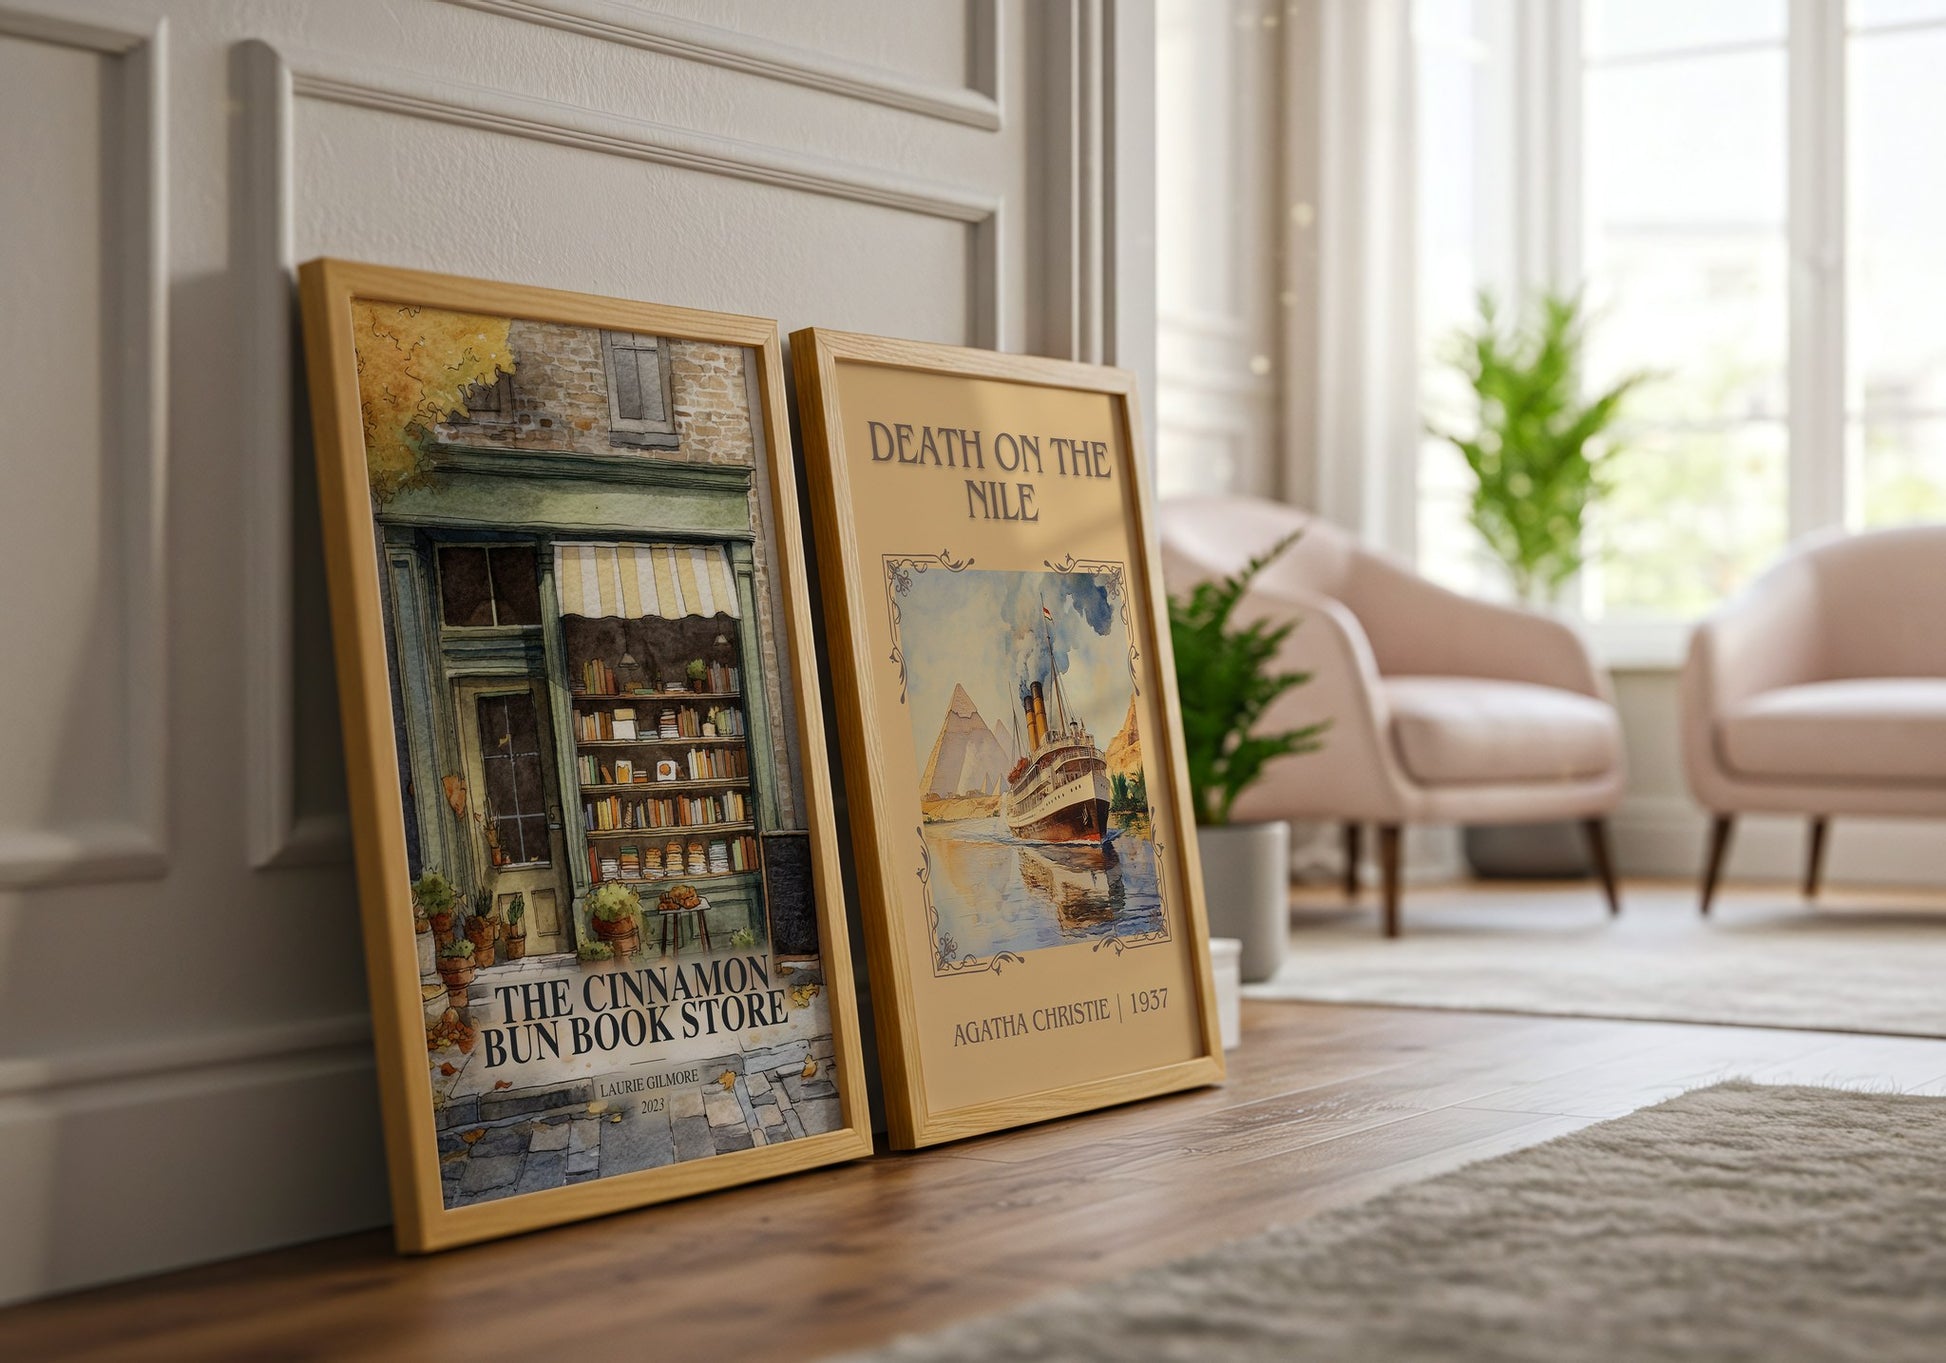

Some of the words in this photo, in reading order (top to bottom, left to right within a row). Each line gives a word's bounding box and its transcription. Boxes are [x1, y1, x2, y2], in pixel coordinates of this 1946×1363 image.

[867, 420, 985, 469] DEATH
[994, 432, 1044, 473] ON
[1050, 437, 1112, 478] THE
[965, 479, 1039, 521] NILE
[495, 979, 574, 1024] THE
[583, 954, 772, 1013] CINNAMON
[954, 1013, 1029, 1047] AGATHA
[1032, 998, 1110, 1032] CHRISTIE
[1130, 988, 1168, 1014] 1937
[481, 1020, 561, 1068] BUN
[569, 1006, 676, 1055] BOOK
[682, 989, 789, 1039] STORE
[600, 1078, 644, 1098] LAURIE
[646, 1069, 700, 1090] GILMORE
[641, 1098, 665, 1115] 2023
